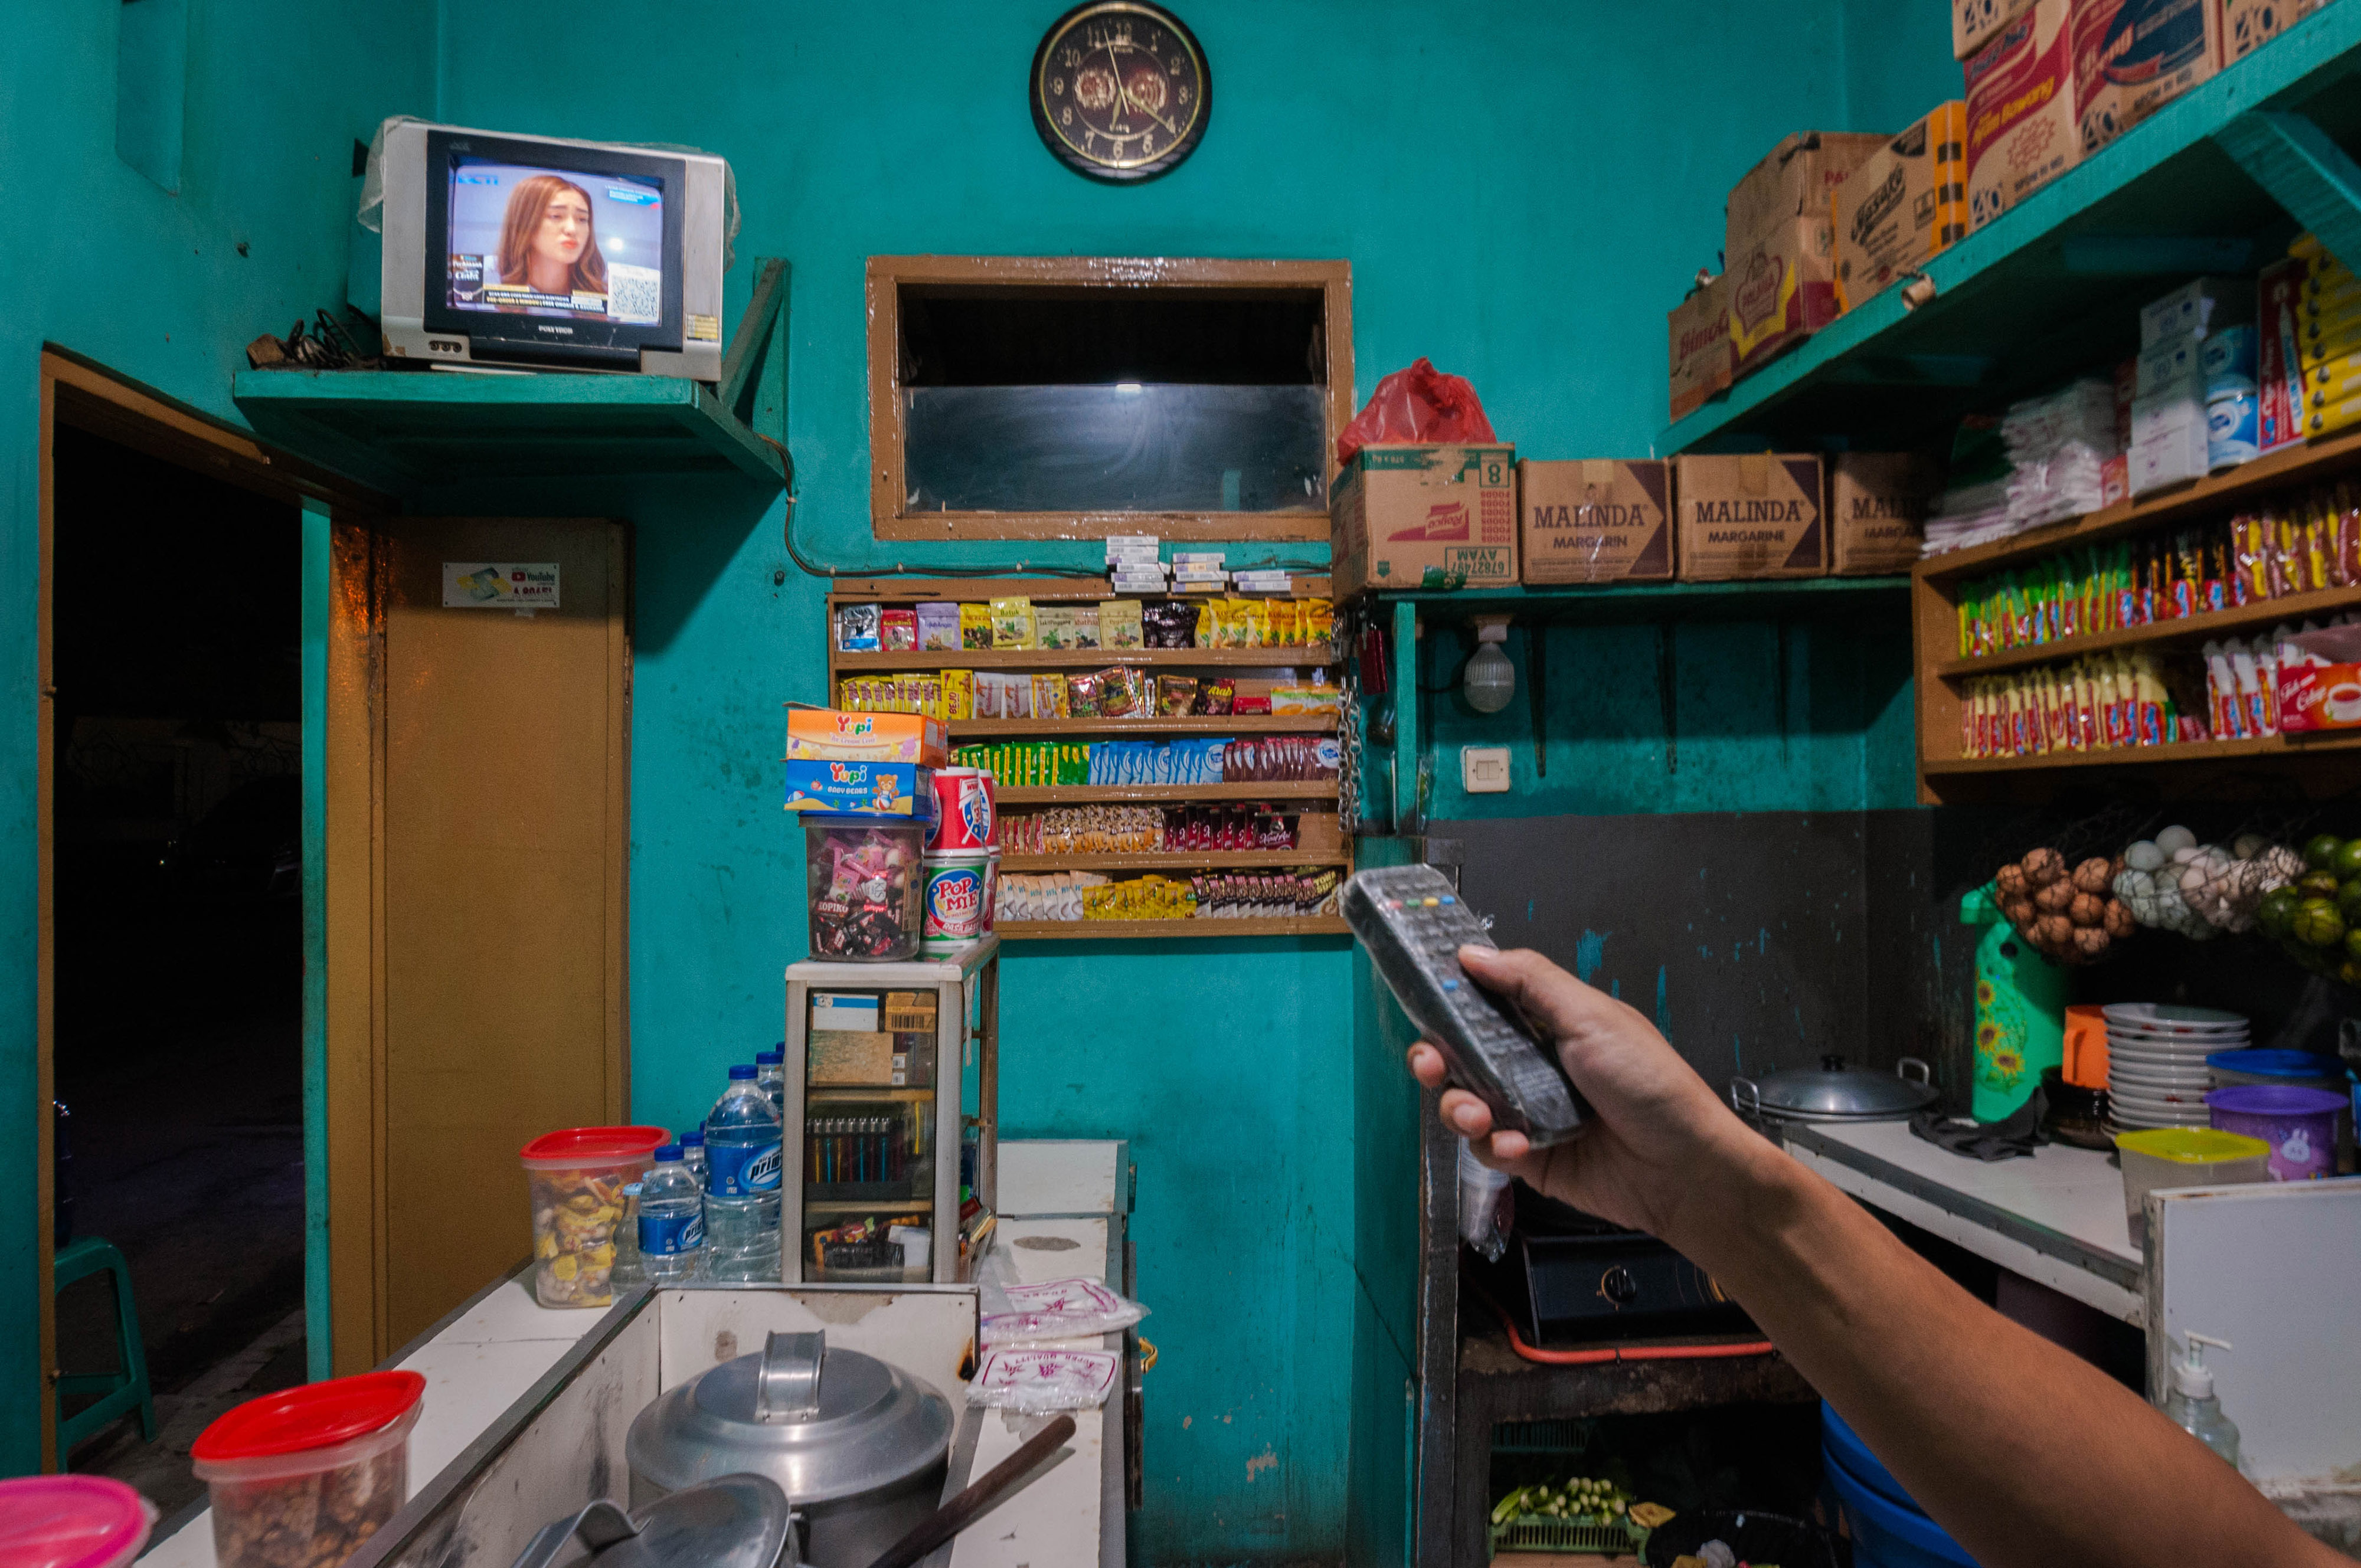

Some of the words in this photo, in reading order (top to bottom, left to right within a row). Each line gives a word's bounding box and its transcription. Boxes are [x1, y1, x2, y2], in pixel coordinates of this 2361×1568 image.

[1062, 106, 1072, 126] 8
[538, 325, 573, 335] POLYTRON
[1488, 464, 1501, 484] 8
[1533, 503, 1644, 529] MALINDA
[1696, 500, 1801, 522] MALINDA
[1428, 514, 1463, 529] Royco
[1708, 529, 1784, 542] MARGARINE
[1457, 549, 1497, 560] AYAM
[527, 572, 555, 582] YouTube
[837, 715, 872, 735] Yupi
[830, 763, 867, 784] Yupi
[828, 786, 845, 794] BABY
[938, 878, 972, 899] POP
[946, 892, 979, 911] MIE
[943, 922, 963, 934] RASA
[750, 1154, 782, 1181] prim
